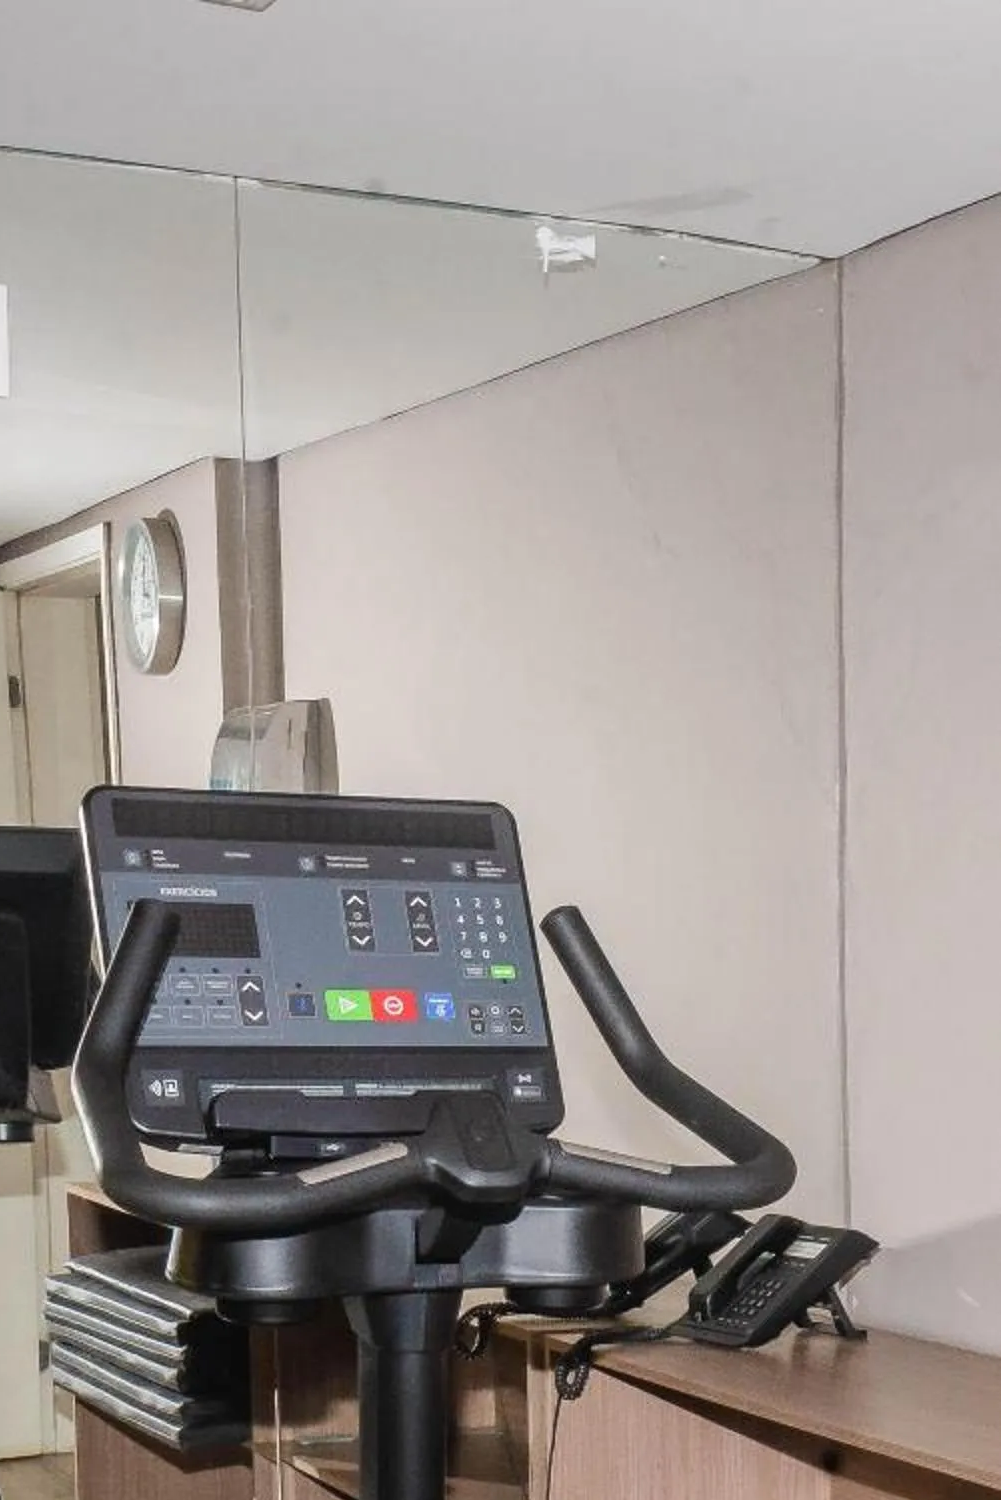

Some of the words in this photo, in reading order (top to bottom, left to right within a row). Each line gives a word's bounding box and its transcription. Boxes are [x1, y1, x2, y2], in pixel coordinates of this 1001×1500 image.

[454, 897, 461, 908] 1
[474, 897, 482, 909] 2
[494, 897, 502, 909] 3
[457, 915, 465, 924] 4
[476, 914, 485, 925] 5
[496, 915, 504, 926] 6
[460, 931, 467, 941] 7
[479, 931, 488, 943] 8
[499, 931, 507, 943] 9
[482, 949, 490, 959] 0
